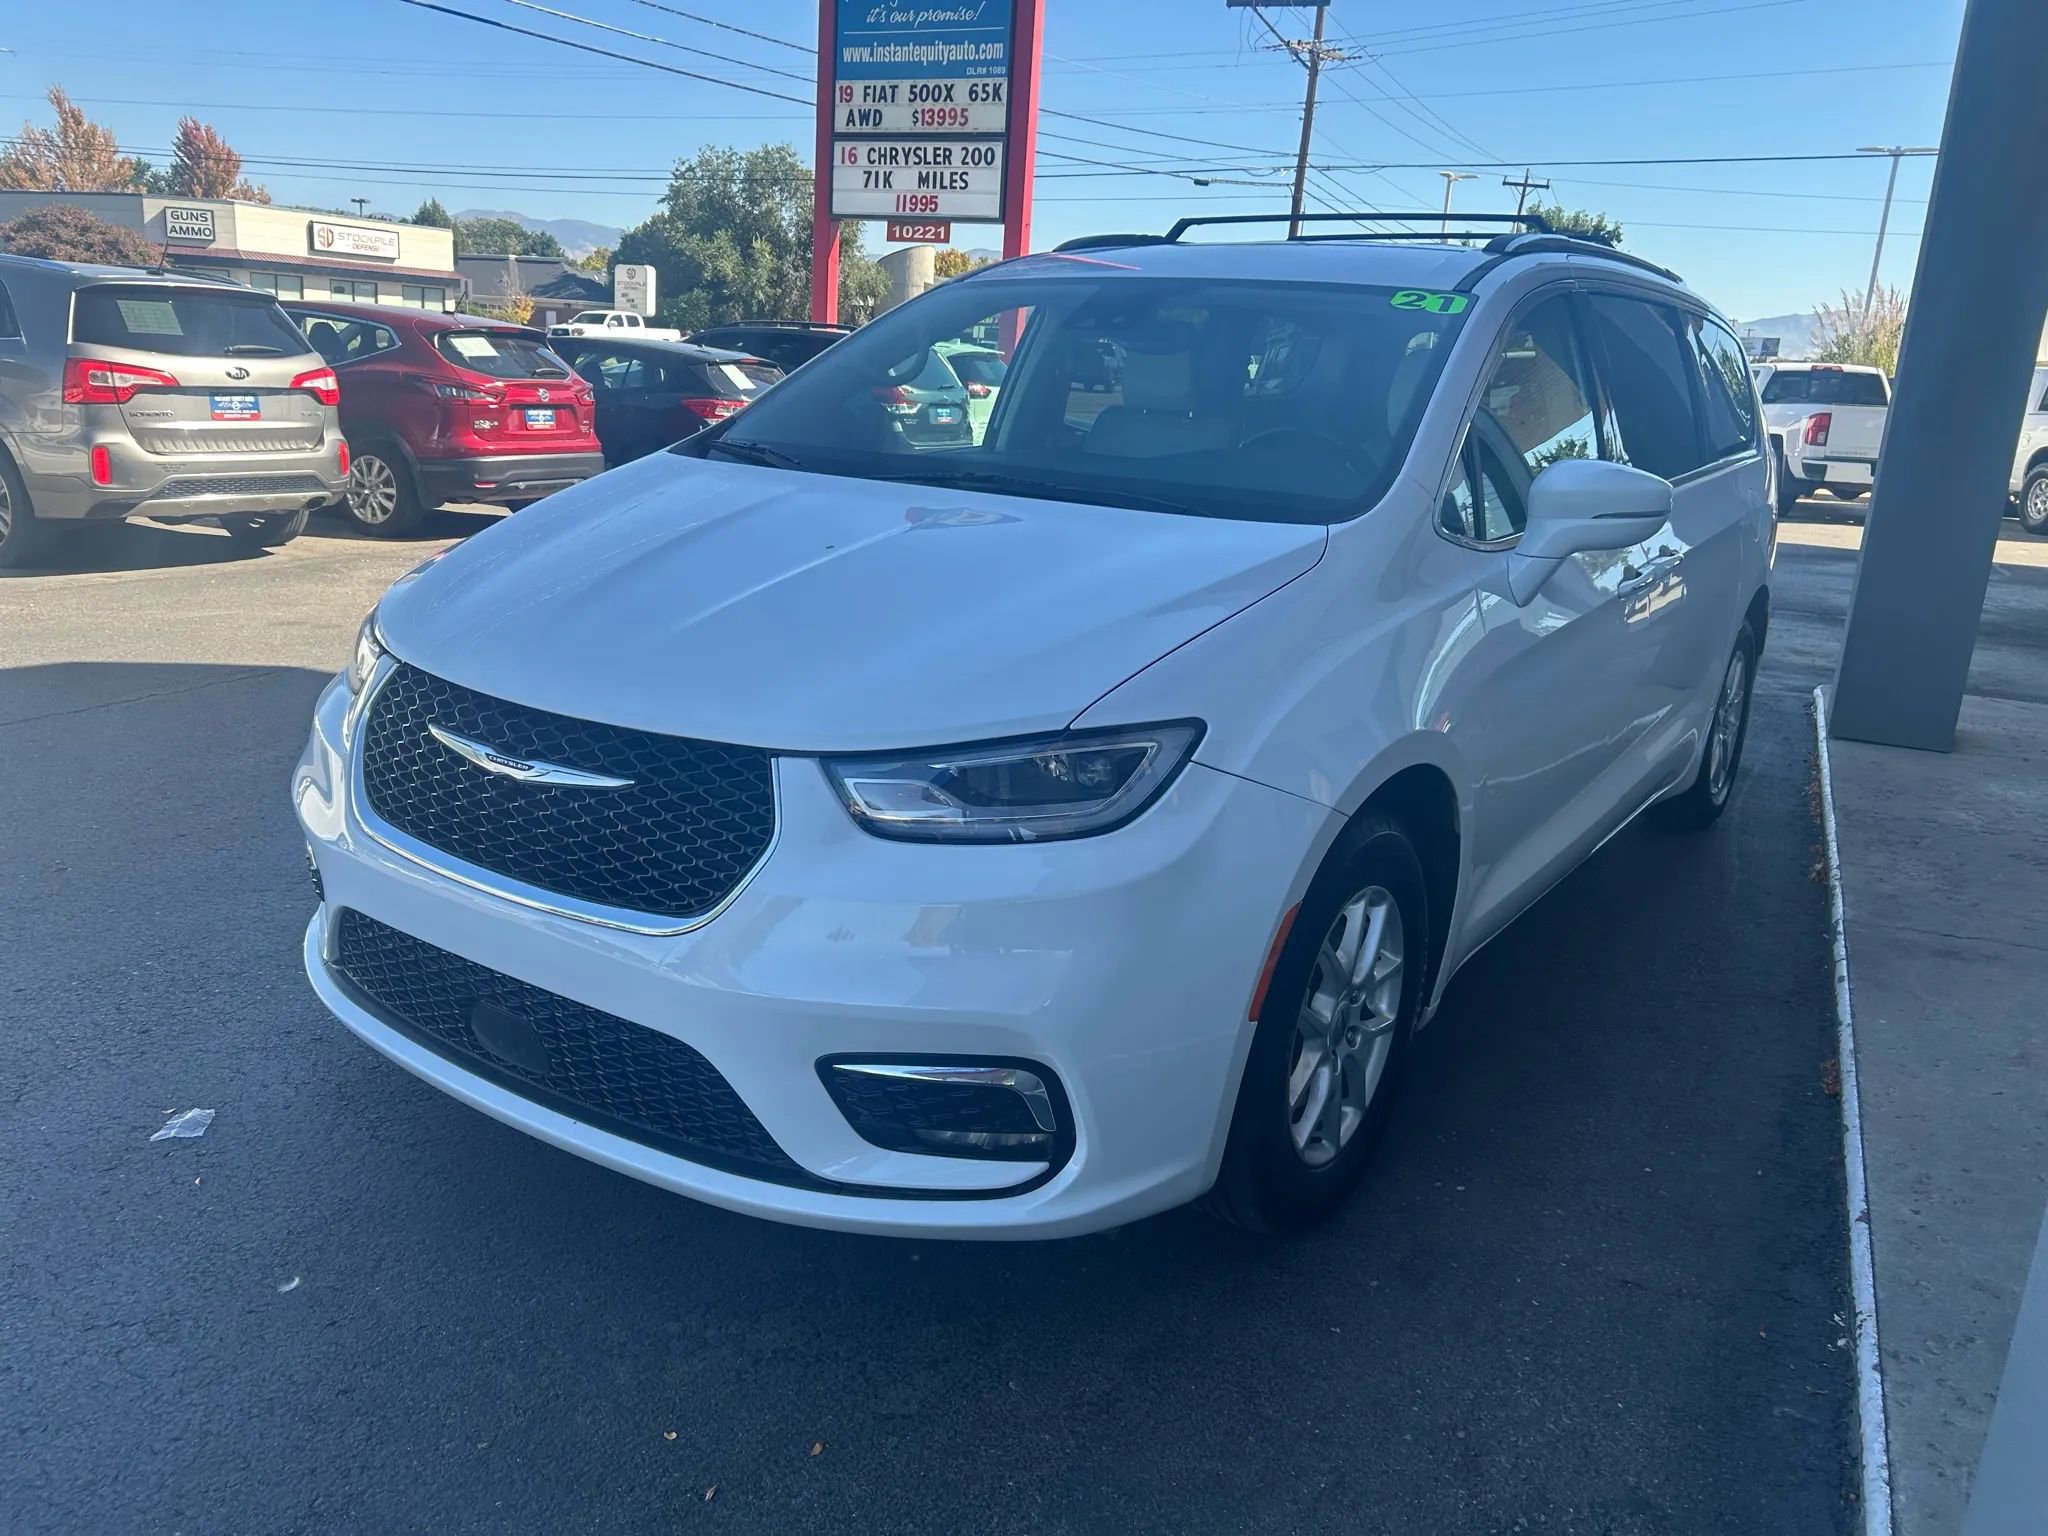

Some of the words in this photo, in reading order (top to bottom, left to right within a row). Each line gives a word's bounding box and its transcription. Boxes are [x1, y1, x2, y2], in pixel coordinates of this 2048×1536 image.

[866, 4, 887, 24] it's
[889, 9, 916, 24] our
[913, 1, 986, 29] promise!
[842, 39, 1004, 66] www.instantequityauto.com
[966, 66, 987, 76] DLR#
[838, 85, 854, 103] 19
[863, 84, 899, 103] FIAT
[908, 83, 955, 103] 500X
[968, 82, 1003, 102] 65K
[845, 108, 883, 127] AWD
[912, 107, 969, 127] $13995
[840, 146, 858, 165] 16
[866, 146, 953, 166] CHRYSLER
[960, 146, 996, 166] 200
[863, 170, 893, 189] 71K
[917, 171, 969, 191] MILES
[895, 194, 939, 214] 11995
[170, 209, 209, 223] GUNS
[168, 224, 213, 238] AMMO
[337, 231, 396, 247] STOCKPILE
[892, 225, 946, 240] 10221
[1395, 292, 1457, 313] 21
[487, 754, 530, 771] CHRYSLER
